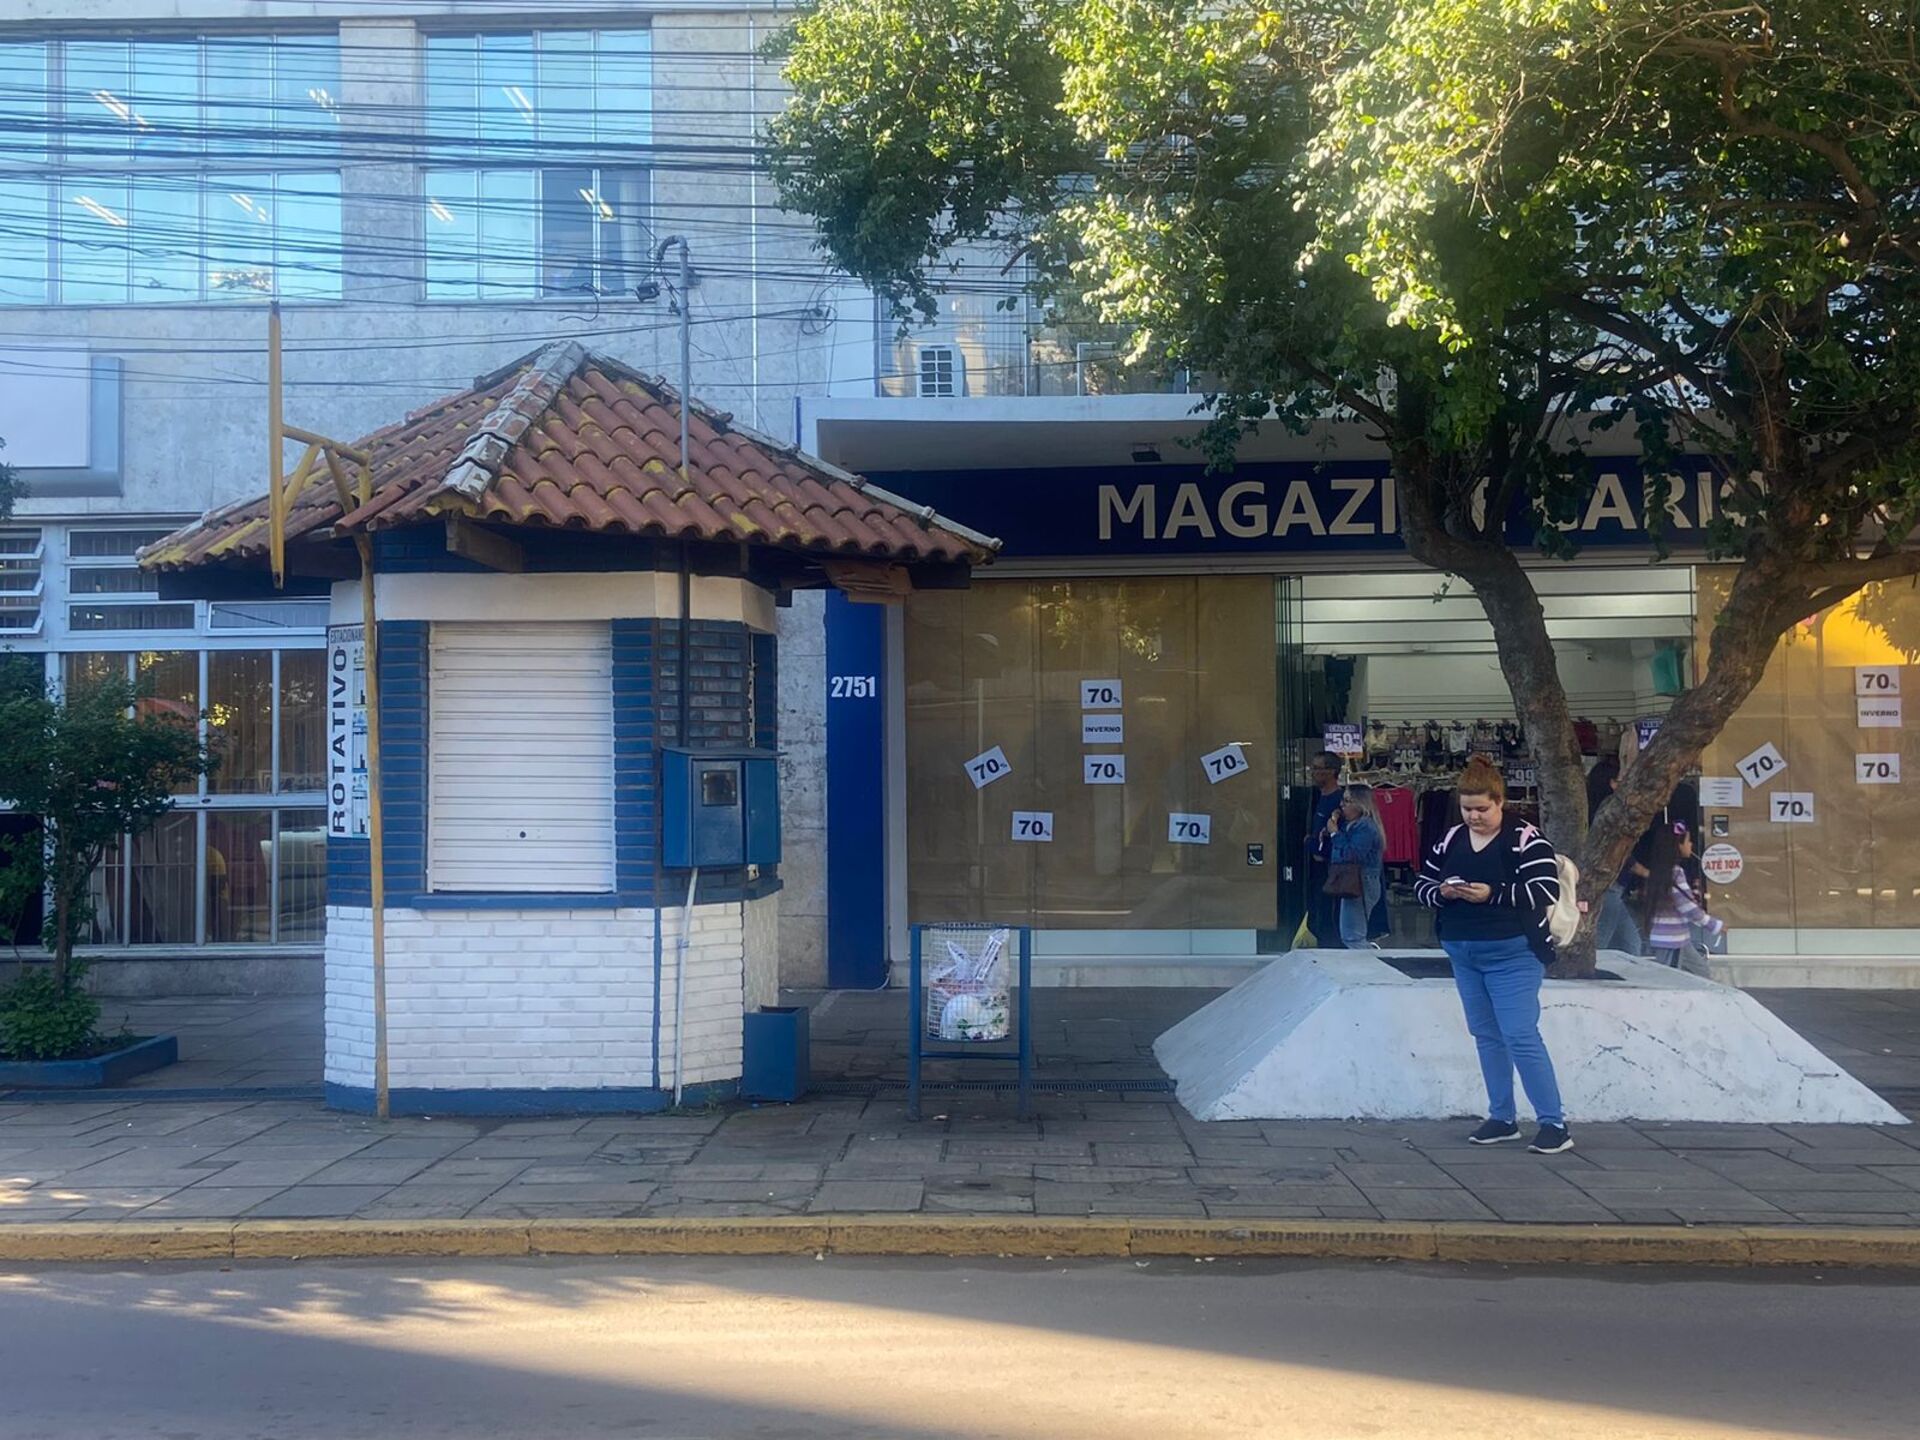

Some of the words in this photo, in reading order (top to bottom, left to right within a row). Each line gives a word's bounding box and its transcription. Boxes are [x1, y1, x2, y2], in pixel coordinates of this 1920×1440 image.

[1097, 473, 1506, 541] MAGAZI
[831, 676, 876, 698] 2751
[332, 648, 347, 834] ROTATIVO
[1705, 858, 1722, 870] ATÉ
